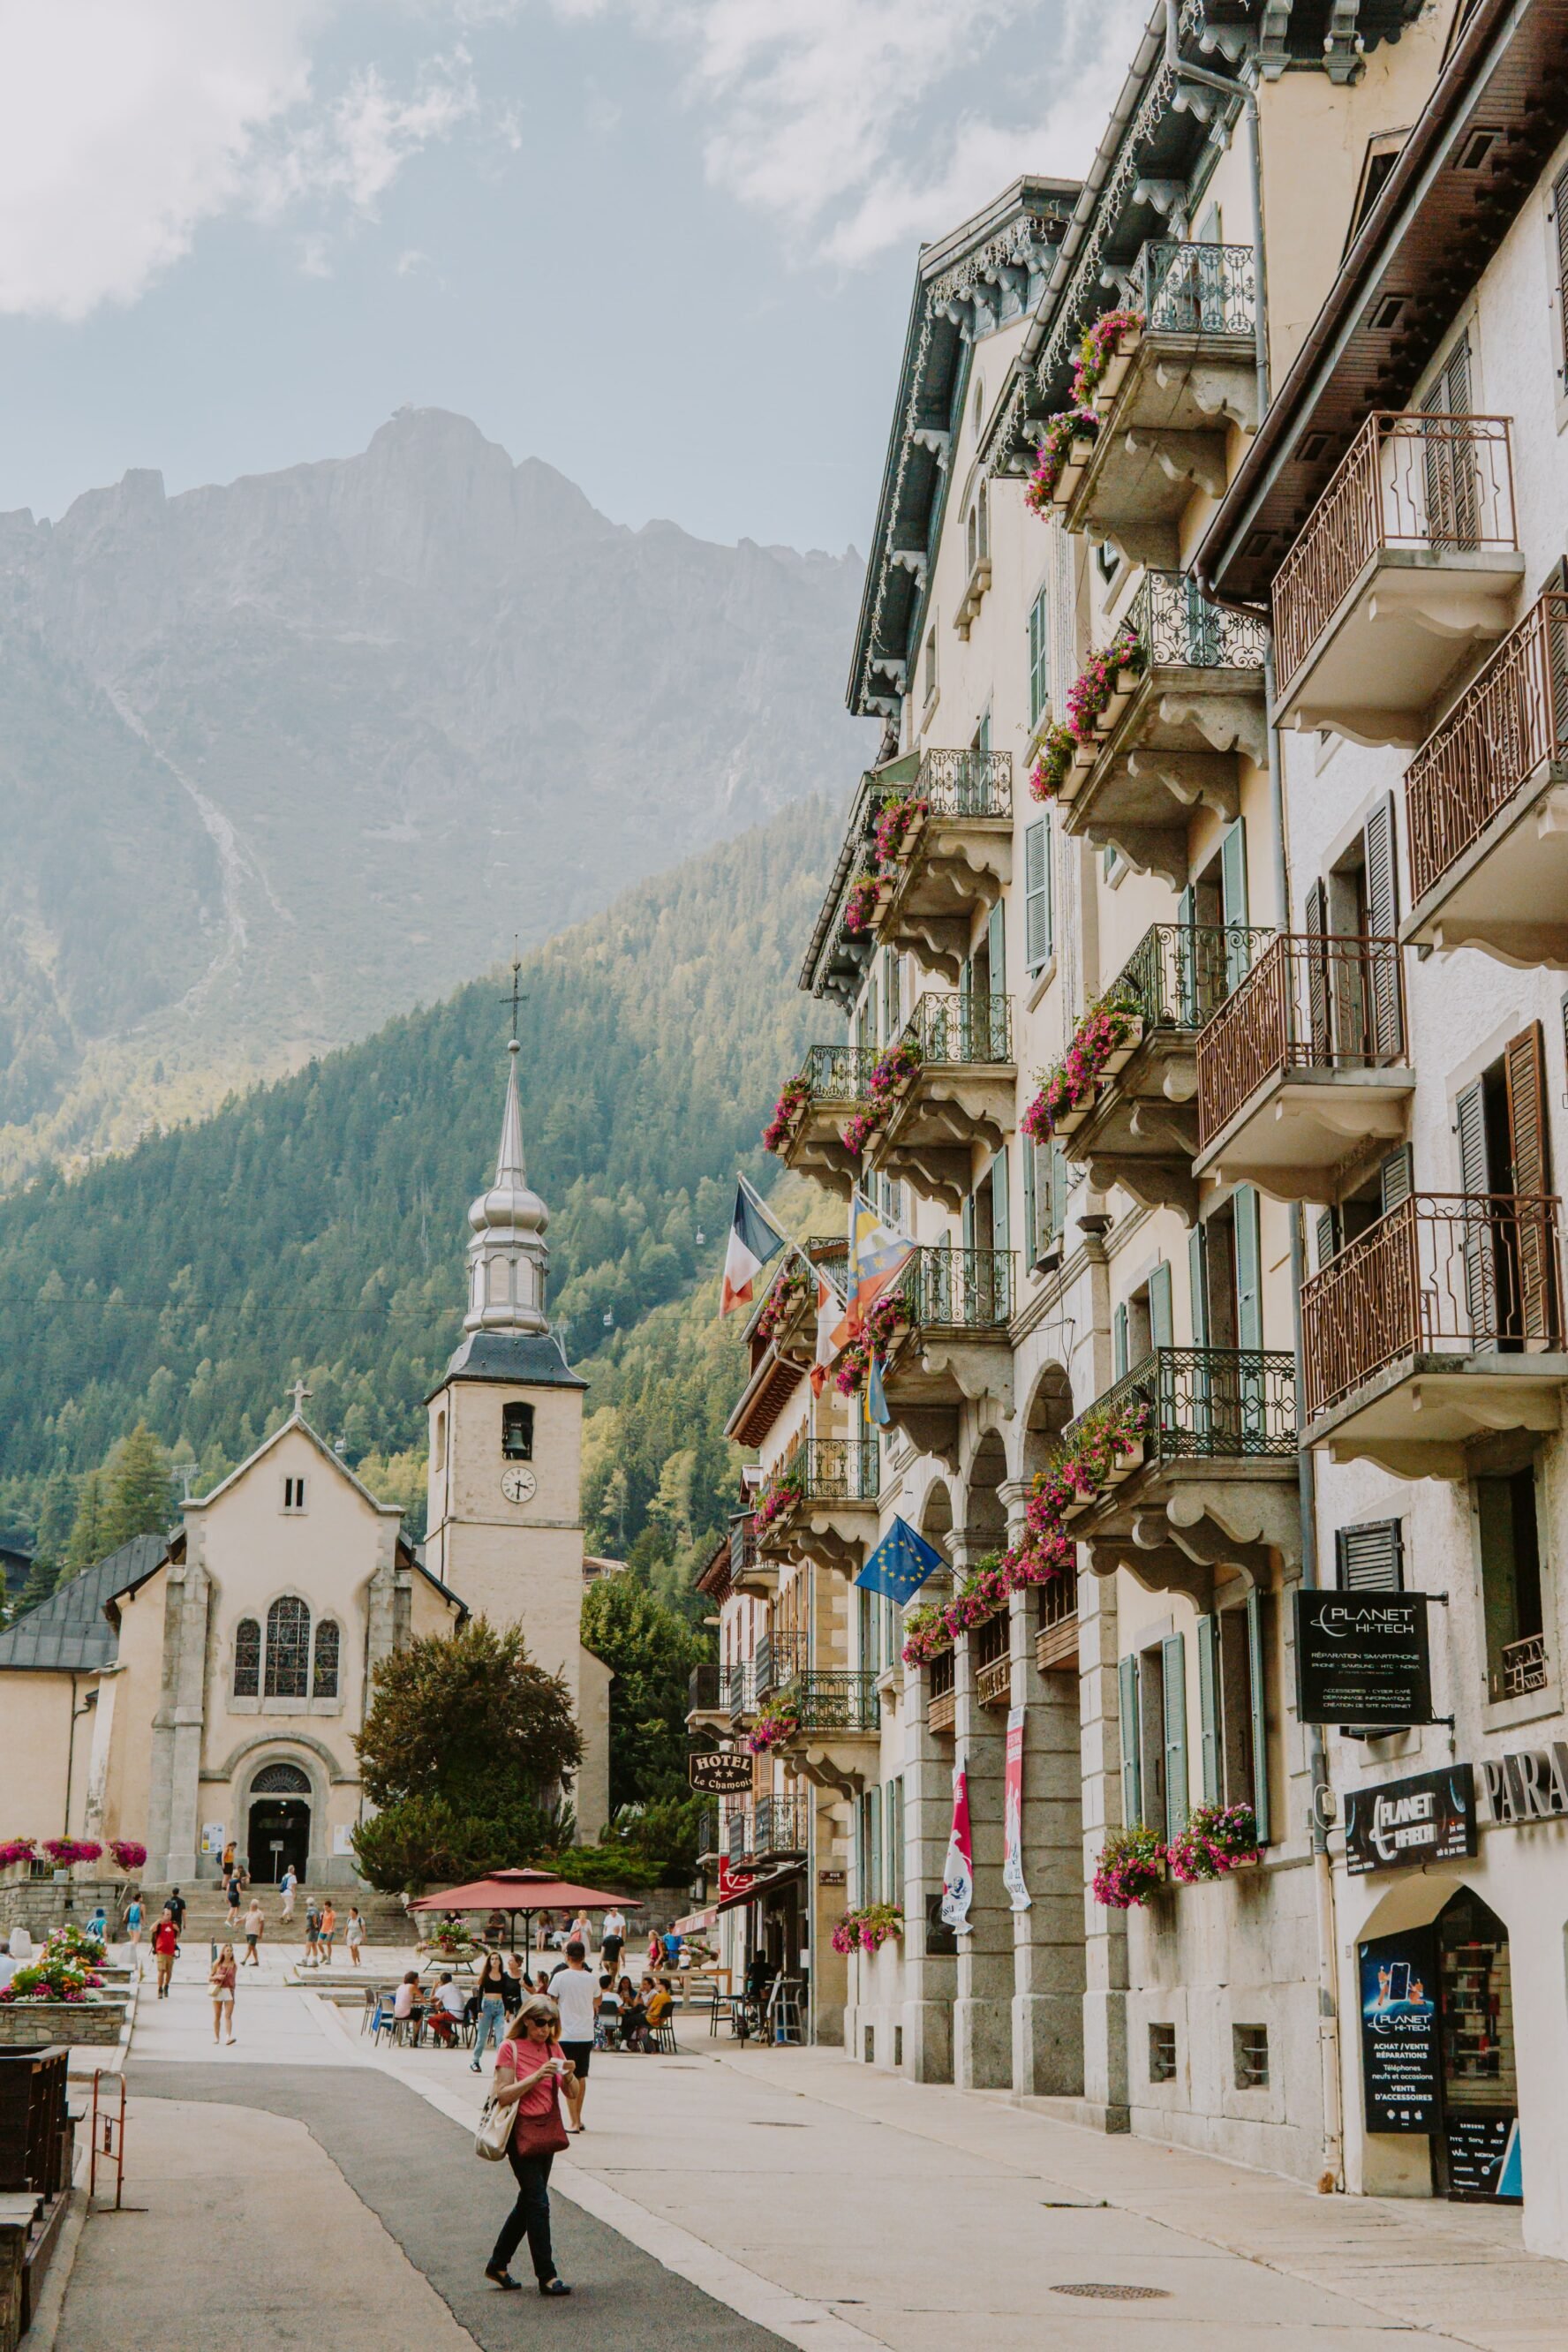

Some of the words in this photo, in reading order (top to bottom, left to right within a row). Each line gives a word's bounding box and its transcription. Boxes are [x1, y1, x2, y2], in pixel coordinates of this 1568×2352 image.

[1331, 1608, 1413, 1621] PLANET
[1355, 1624, 1414, 1633] HI-TECH
[696, 1754, 750, 1771] HOTEL
[693, 1775, 705, 1786] Le
[708, 1777, 753, 1790] Chamonix
[1380, 1792, 1436, 1828] PLANET
[1380, 2015, 1430, 2024] PLANET
[1383, 2063, 1421, 2072] Téléphones
